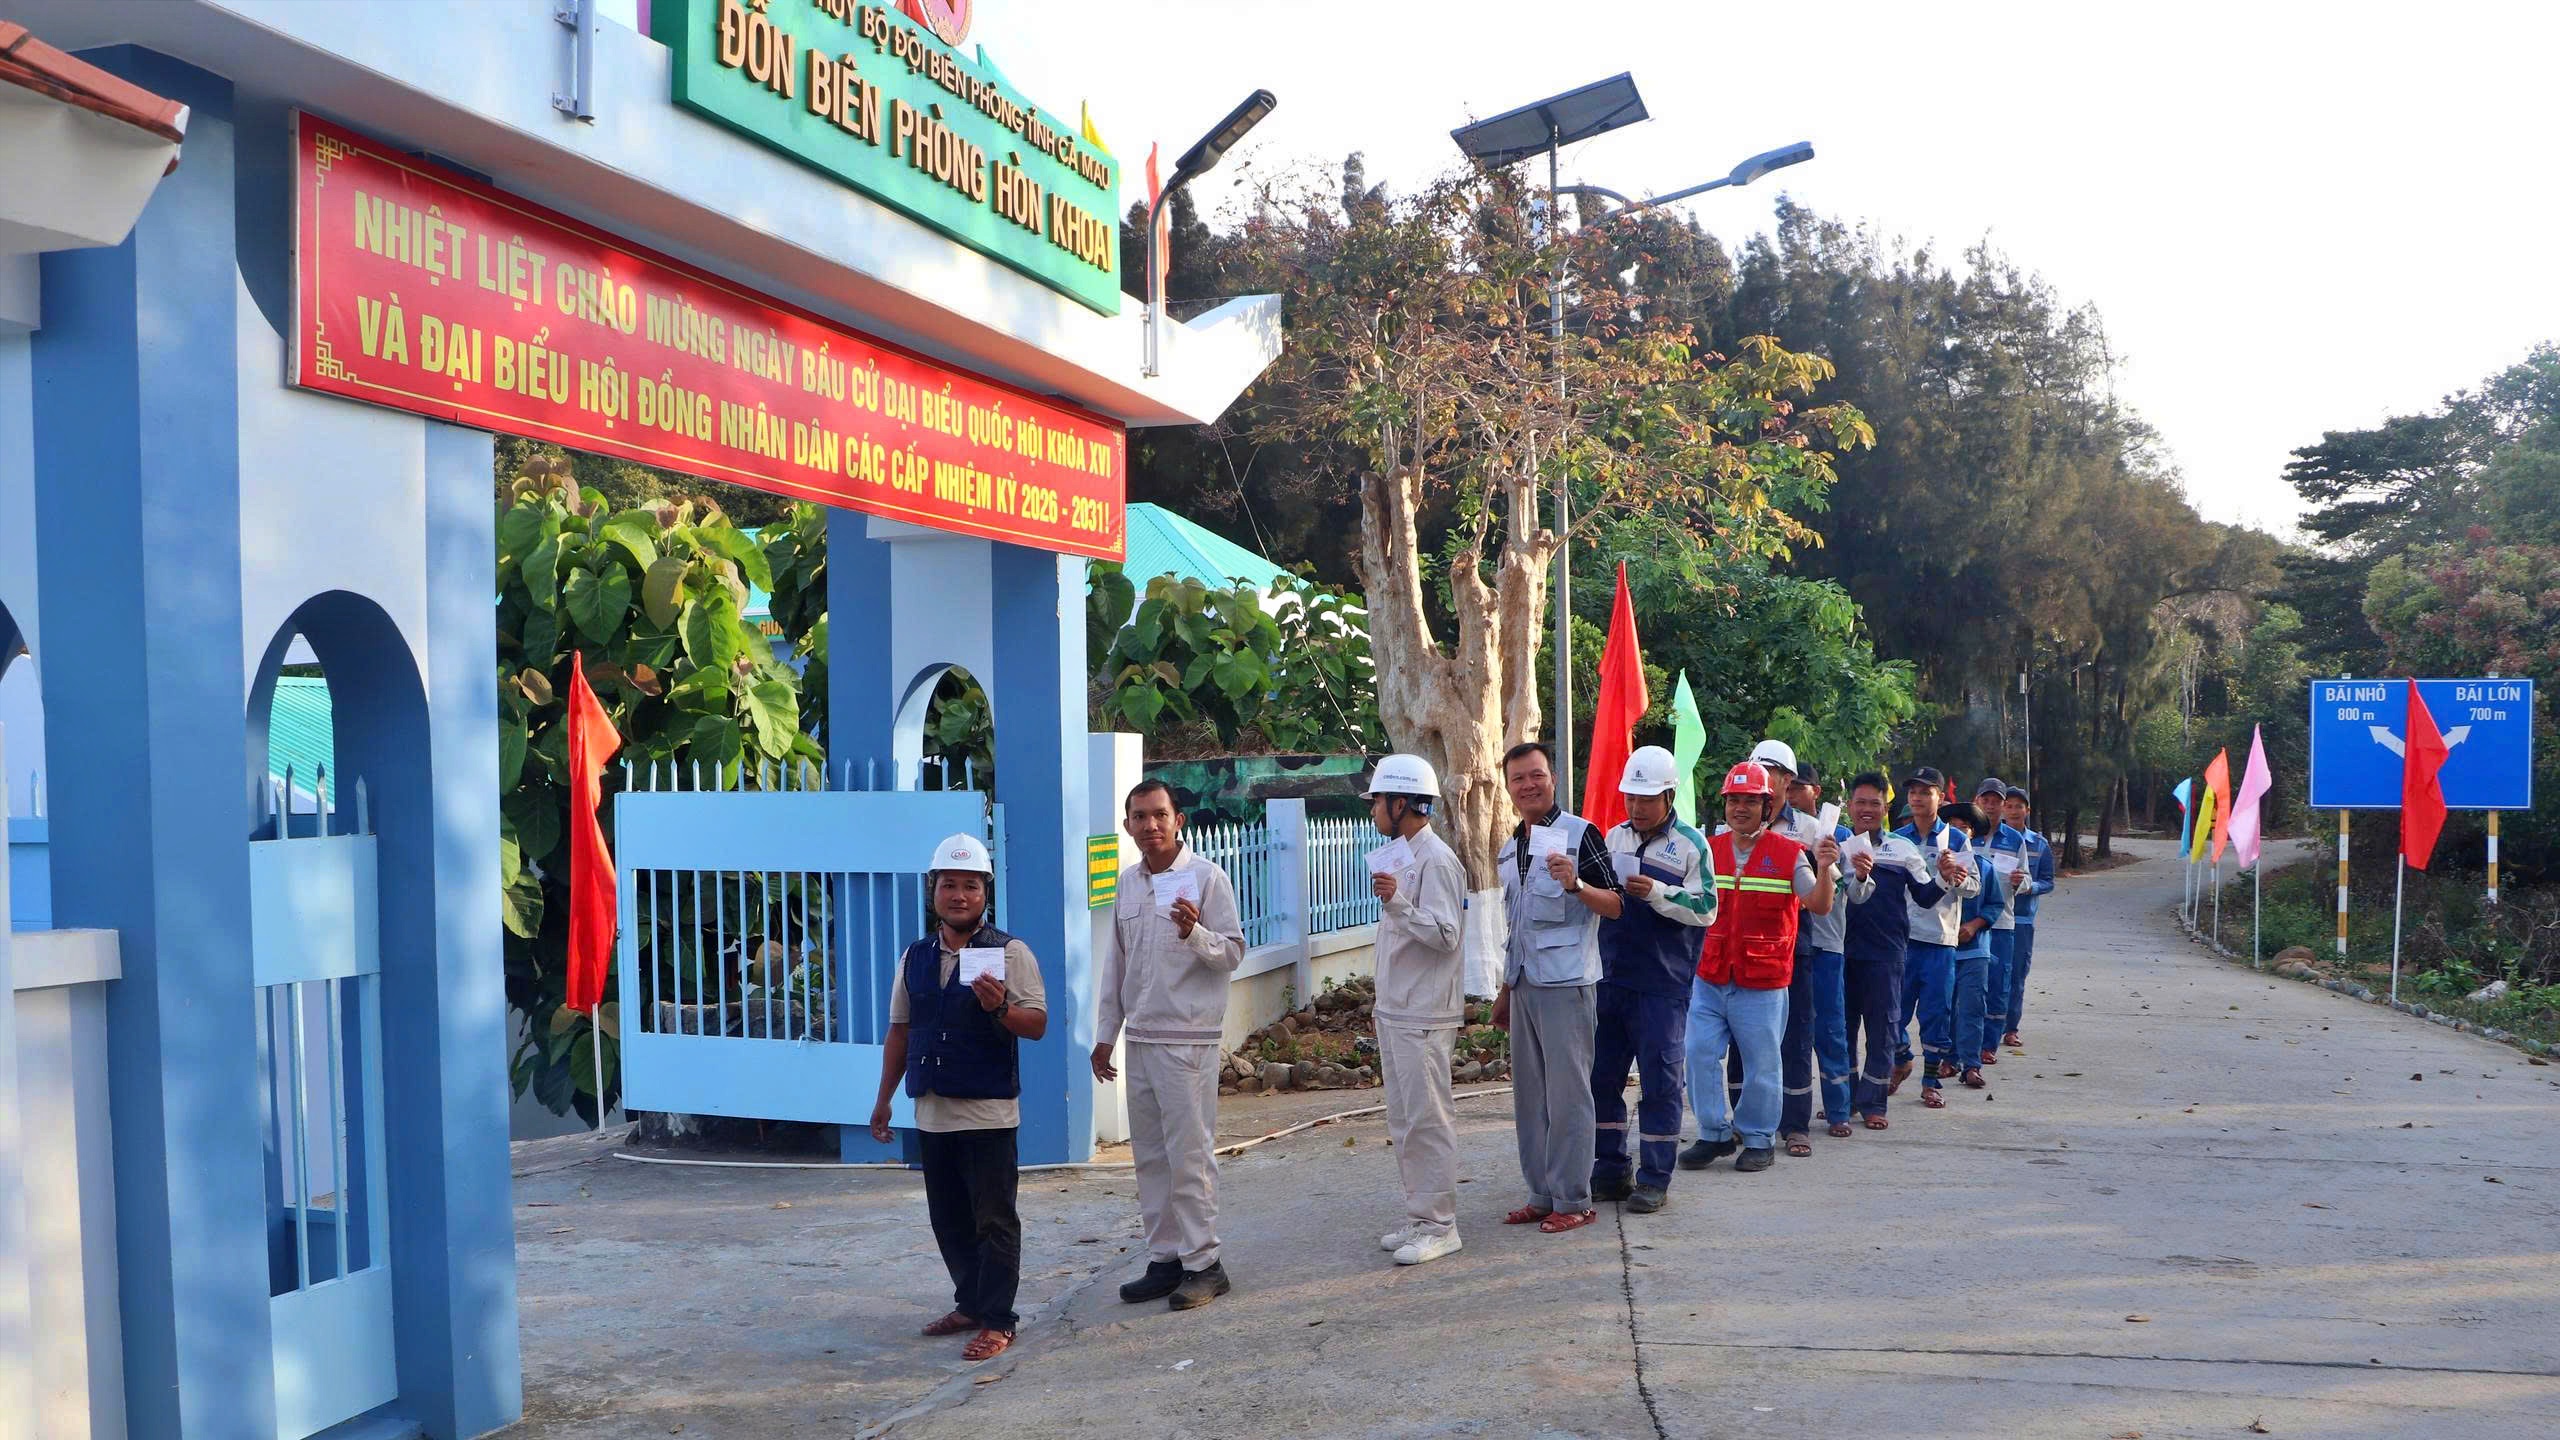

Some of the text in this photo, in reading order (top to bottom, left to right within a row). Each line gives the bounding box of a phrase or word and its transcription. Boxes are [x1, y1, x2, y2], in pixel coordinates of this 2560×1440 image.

[860, 5, 889, 54] BỘ
[891, 26, 926, 74] ĐỘI
[926, 48, 966, 99] BIÊN
[968, 76, 1024, 133] PHÒNG
[1024, 104, 1055, 156] TỈNH
[1056, 135, 1078, 170] CÀ
[1079, 151, 1110, 190] MAU
[807, 48, 881, 146] BIÊN
[891, 98, 985, 203] PHÒNG
[993, 152, 1042, 235] HÒN
[1048, 192, 1112, 273] KHOAI
[354, 190, 1111, 479] NHIỆT LIỆT CHÀO MỪNG NGÀY BẦU CỬ ĐẠI BIỂU QUỐC HỘI KHÓA XVI
[357, 292, 1110, 534] VÀ ĐẠI BIỂU HỘI ĐỒNG NHÂN DÂN CÁC CẤP NHIỆM KỲ 2026 - 2031!
[2325, 683, 2386, 702] BÃI NHỎ
[2337, 707, 2375, 721] 800 m
[2455, 682, 2521, 701] BÃI LỚN
[2469, 707, 2506, 721] 700 m
